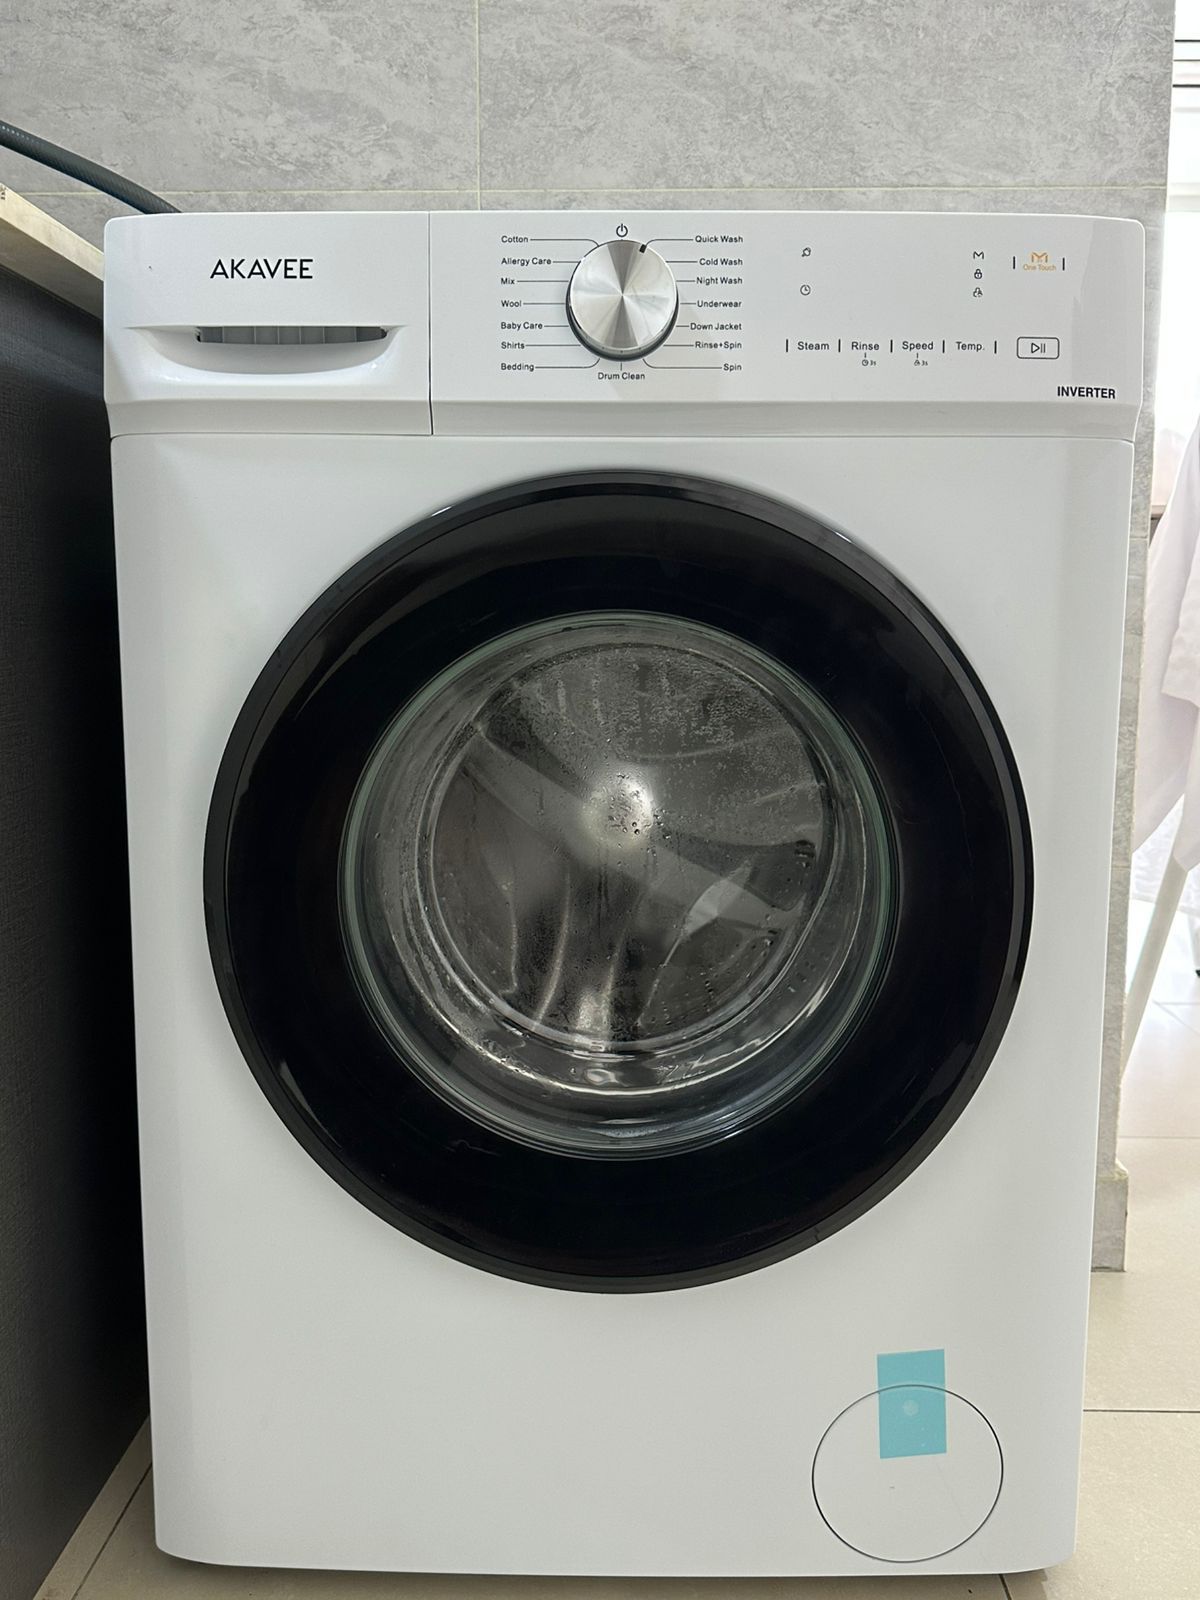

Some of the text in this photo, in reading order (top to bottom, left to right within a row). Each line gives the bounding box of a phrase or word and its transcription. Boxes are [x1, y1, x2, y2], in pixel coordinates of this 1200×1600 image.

[501, 235, 529, 244] Cotton
[695, 235, 744, 244] Quick Wash
[501, 257, 552, 267] Allergy Care
[699, 257, 744, 266] Cold Wash
[209, 258, 314, 280] AKAVEE
[1022, 263, 1057, 272] One Touch
[500, 277, 516, 286] Mix
[696, 277, 743, 287] Night Wash
[501, 299, 522, 308] Wool
[697, 299, 743, 308] Underwear
[500, 322, 543, 332] Baby Care
[690, 322, 743, 331] Down Jacket
[500, 341, 525, 350] Shirts
[695, 340, 743, 351] Rinse+Spin
[797, 340, 830, 351] Steam
[851, 340, 880, 351] Rinse
[902, 340, 934, 353] Speed
[955, 341, 986, 353] Temp.
[500, 362, 535, 373] Bedding
[723, 363, 743, 373] Spin
[597, 371, 646, 381] Drum Clean
[1056, 385, 1116, 400] INVERTER
